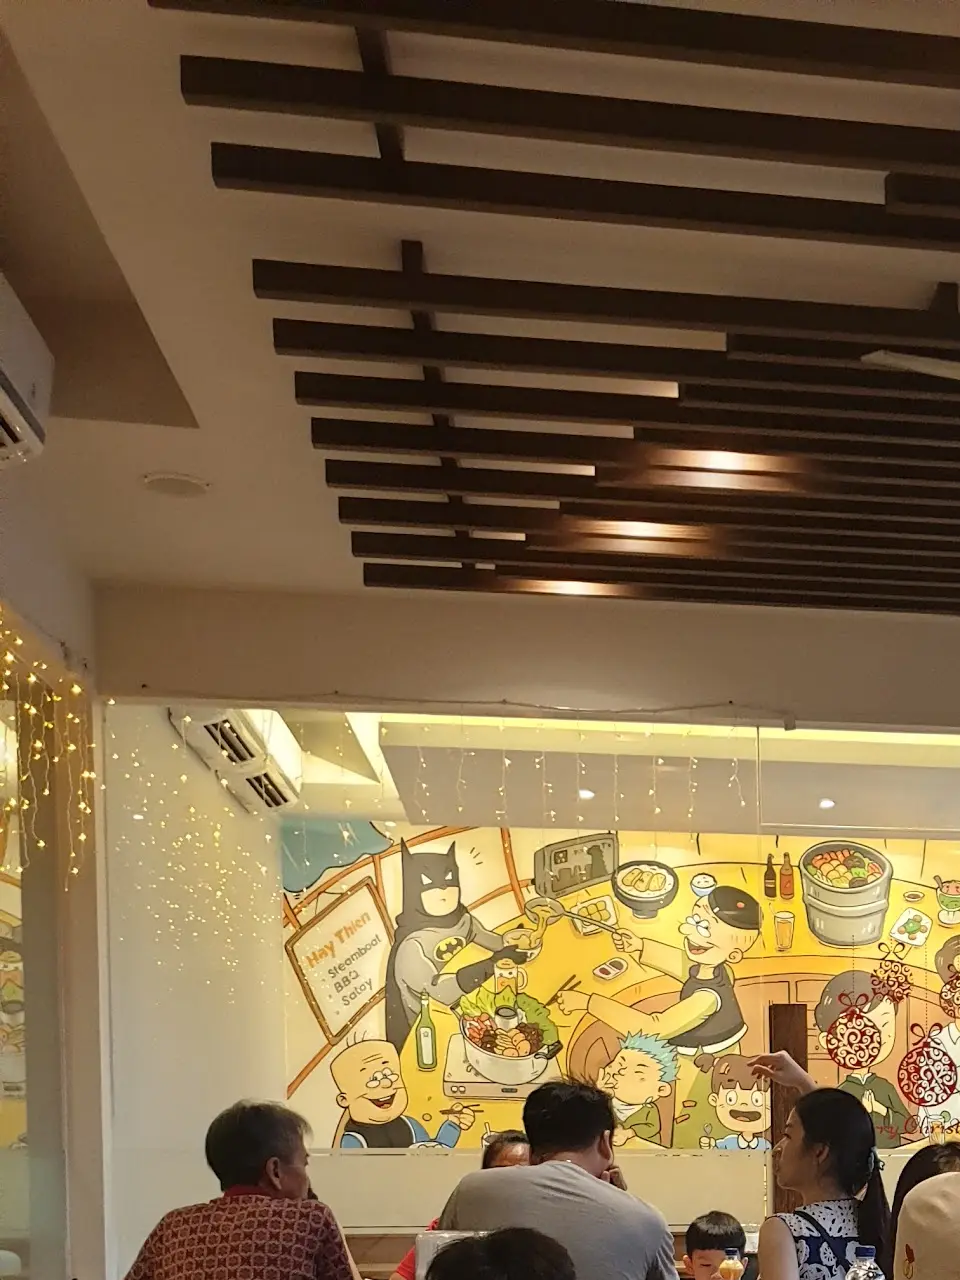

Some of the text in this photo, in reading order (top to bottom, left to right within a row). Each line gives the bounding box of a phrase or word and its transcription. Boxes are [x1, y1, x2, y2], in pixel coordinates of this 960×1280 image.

[305, 910, 372, 969] Hay Thien
[327, 934, 382, 979] Steamboat
[333, 970, 361, 994] BBQ
[341, 978, 373, 1007] Satay
